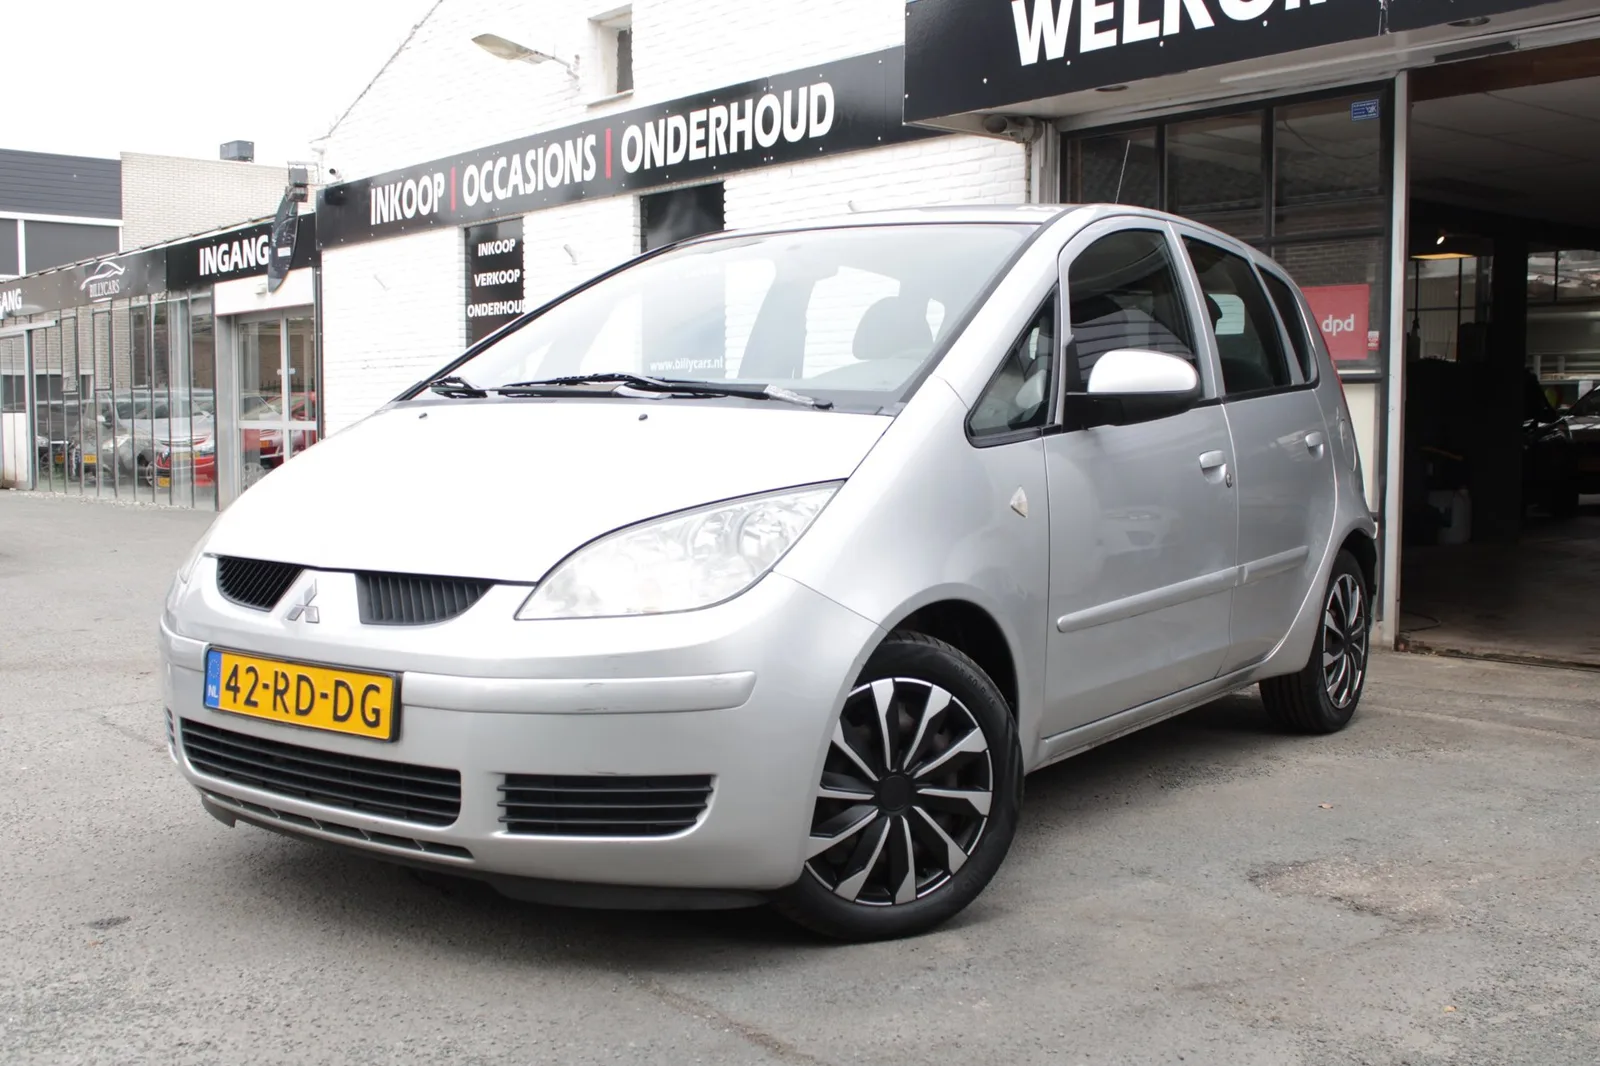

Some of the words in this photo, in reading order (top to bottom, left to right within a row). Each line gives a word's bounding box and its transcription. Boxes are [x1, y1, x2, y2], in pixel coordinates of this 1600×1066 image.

[370, 172, 445, 226] INKOOP
[462, 134, 597, 207] OCCASIONS
[621, 82, 835, 174] ONDERHOUD
[199, 234, 269, 276] INGANG
[478, 238, 516, 257] INKOOP
[474, 269, 521, 287] VERKOOP
[0, 288, 22, 313] ANG
[1321, 313, 1355, 337] dpd
[649, 356, 724, 372] www.billycars.nl
[207, 685, 219, 699] NL
[224, 663, 381, 729] 42-RD-DG
